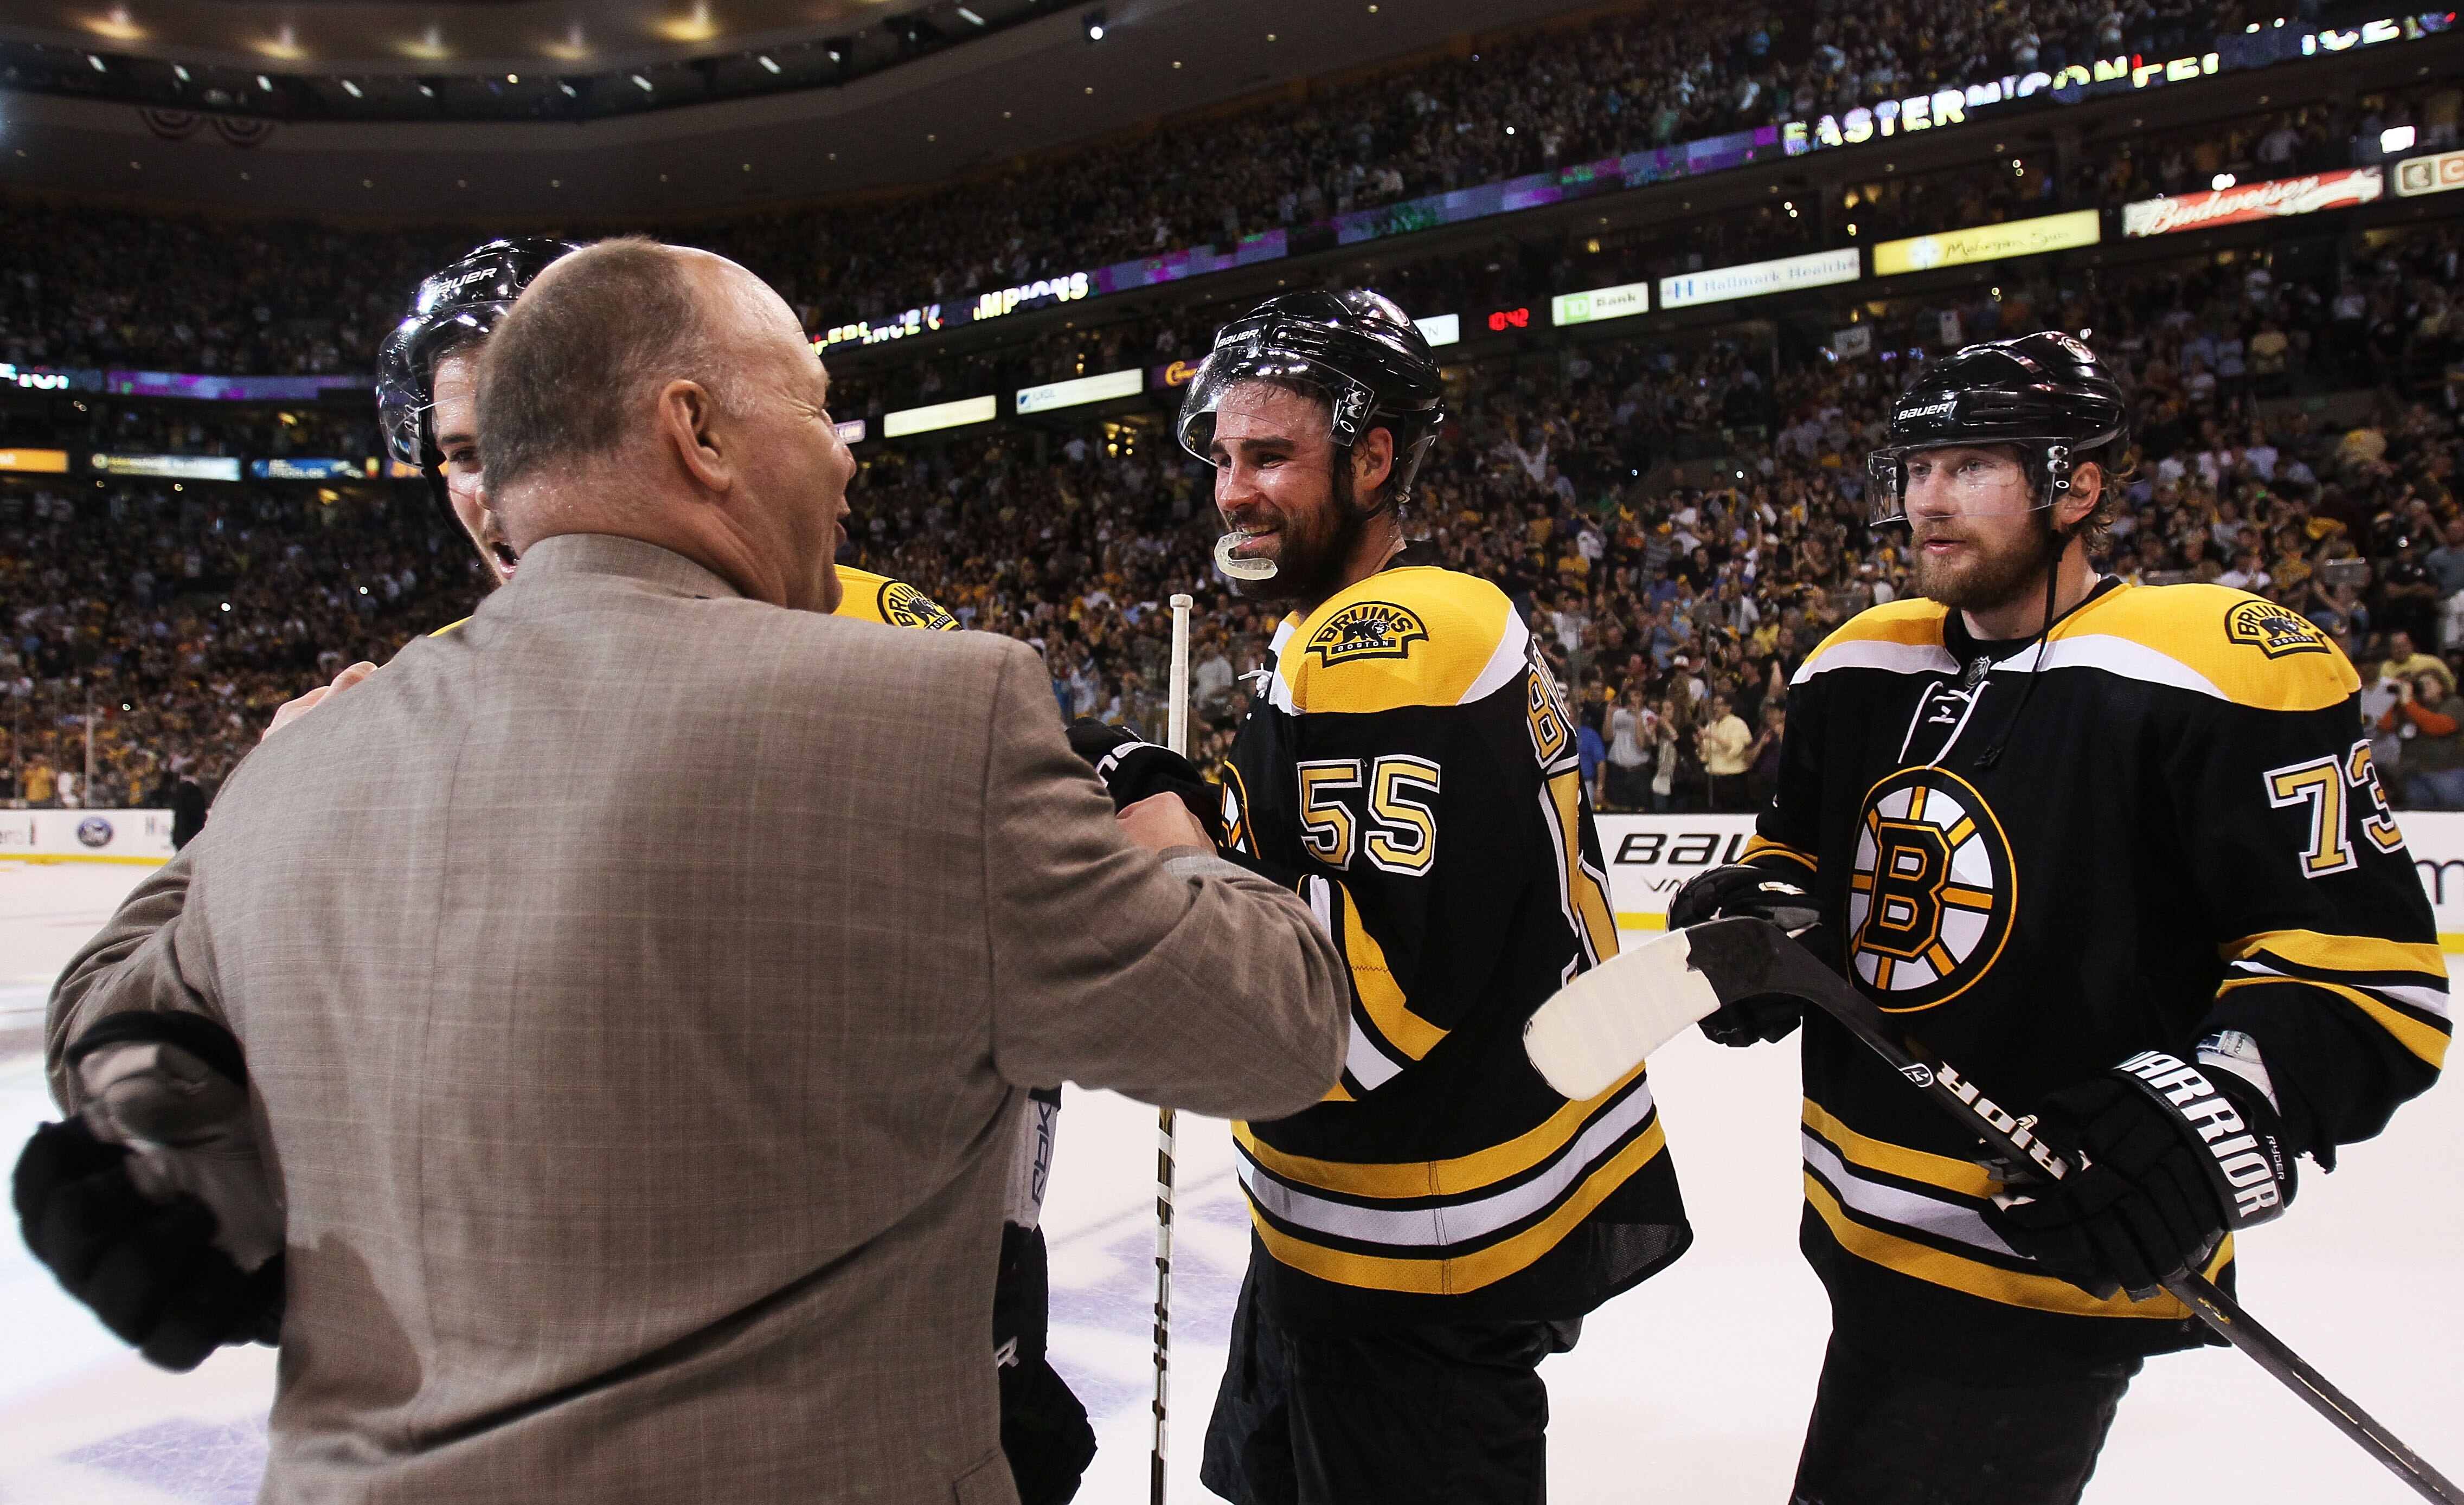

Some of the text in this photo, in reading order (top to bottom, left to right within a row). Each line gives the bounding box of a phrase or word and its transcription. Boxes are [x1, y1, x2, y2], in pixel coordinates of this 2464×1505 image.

[2134, 175, 2320, 237] Budweiser
[433, 267, 498, 295] AUER
[1704, 260, 1848, 292] Hallmark Health
[1567, 292, 1636, 317] TD Bank
[1217, 328, 1260, 348] BAUER
[1898, 402, 1949, 421] BAUER
[1314, 606, 1414, 642] BRUINS
[2237, 605, 2311, 636] BRUINS
[1337, 640, 1389, 652] BOSTON
[2273, 636, 2314, 646] BOSTON
[1297, 754, 1441, 877] 55
[2263, 739, 2407, 879] 73
[2266, 1135, 2286, 1181] RYDER
